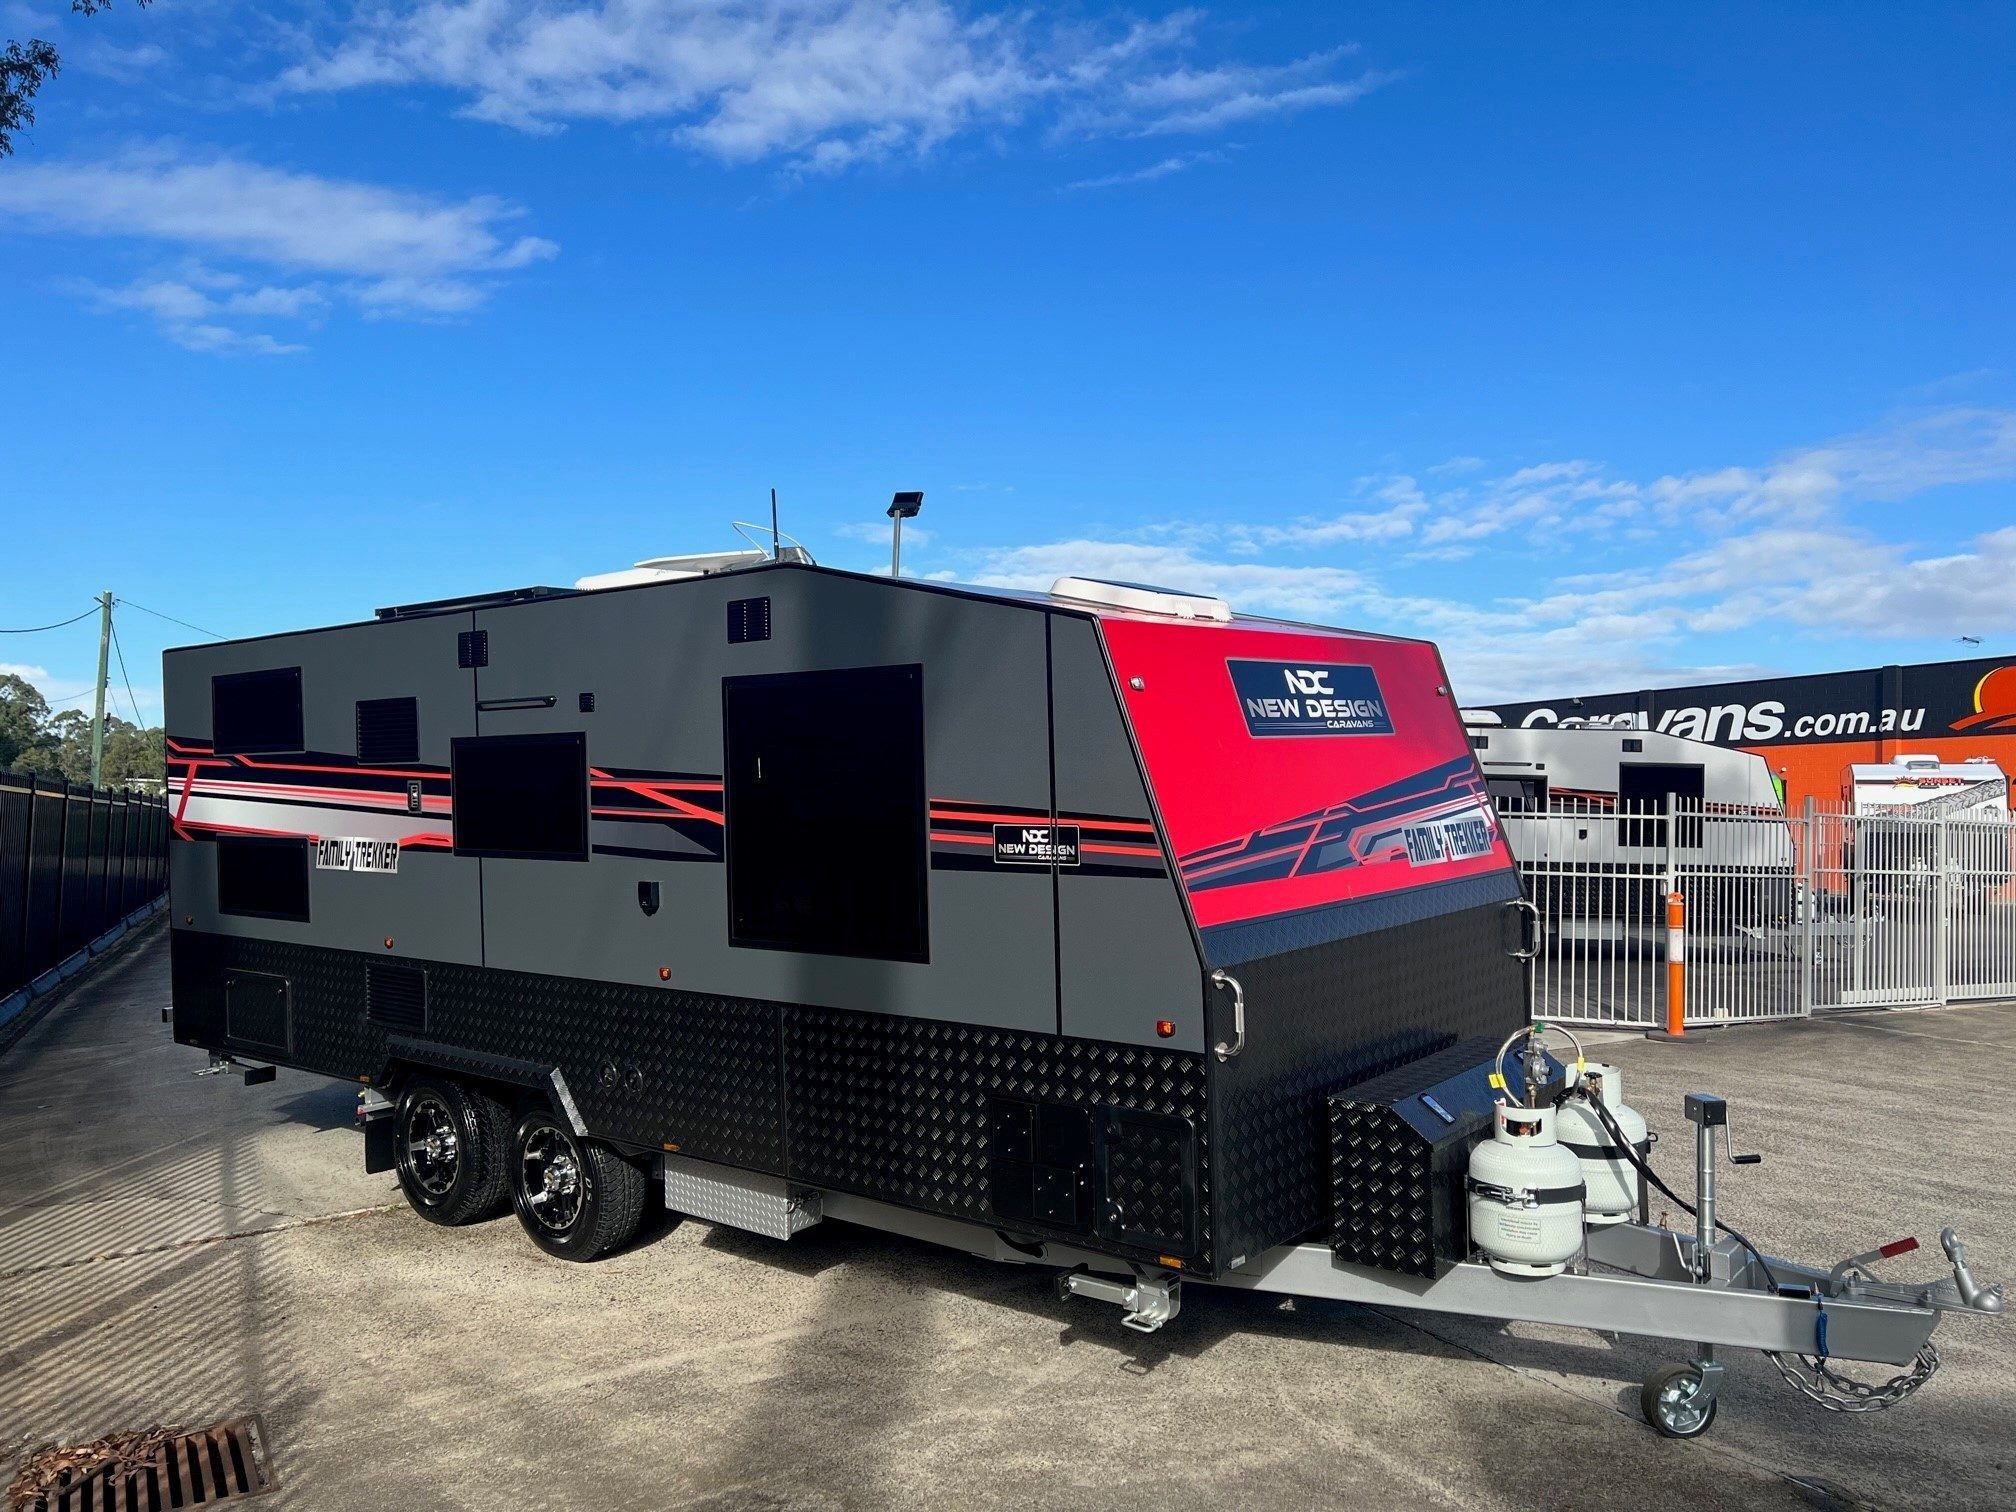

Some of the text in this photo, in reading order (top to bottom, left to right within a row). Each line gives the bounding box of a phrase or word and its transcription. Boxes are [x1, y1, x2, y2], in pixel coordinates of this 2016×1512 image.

[1284, 669, 1334, 695] NDC
[1246, 698, 1383, 718] NEW DESIGN
[1326, 720, 1374, 728] CARAVANS
[1918, 777, 1963, 785] SUNSET
[1022, 829, 1049, 843] NDC
[1404, 820, 1491, 862] FAMILY TREKKER
[318, 840, 397, 870] FAMILY TREKKER
[998, 844, 1075, 855] NEW DESIGN
